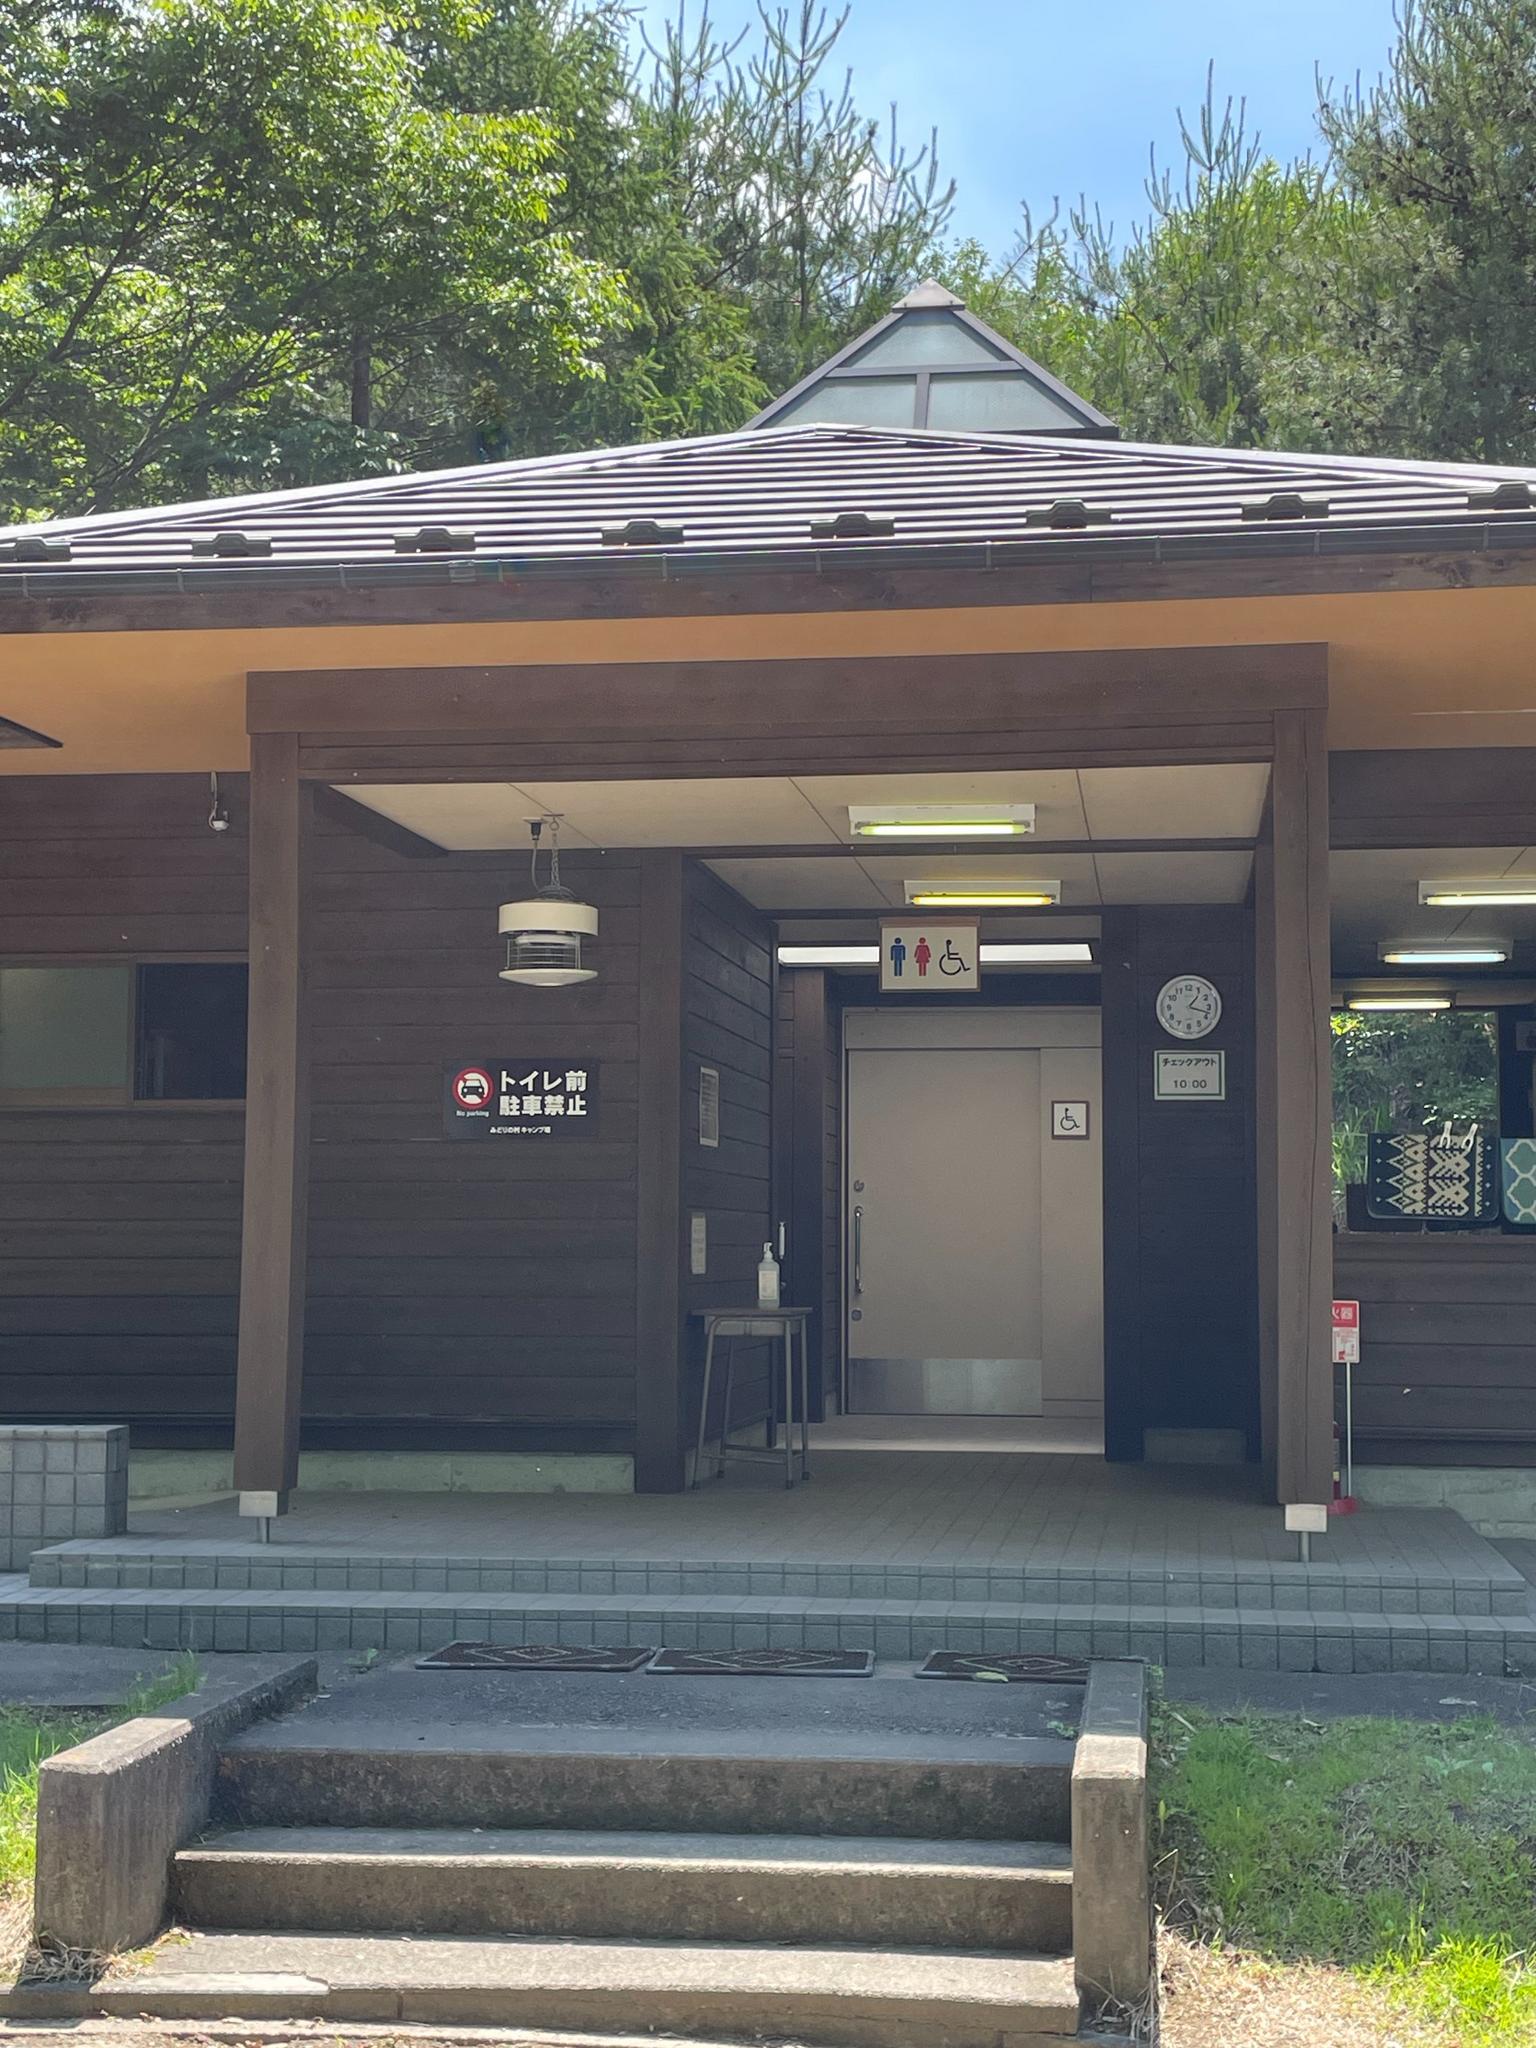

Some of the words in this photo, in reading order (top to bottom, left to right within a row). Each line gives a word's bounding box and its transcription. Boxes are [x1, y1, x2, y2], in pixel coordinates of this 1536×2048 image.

[1161, 1058, 1217, 1067] チェックアウト
[500, 1070, 588, 1092] トイレ前
[499, 1094, 588, 1116] 駐車禁止
[466, 1110, 490, 1118] parking
